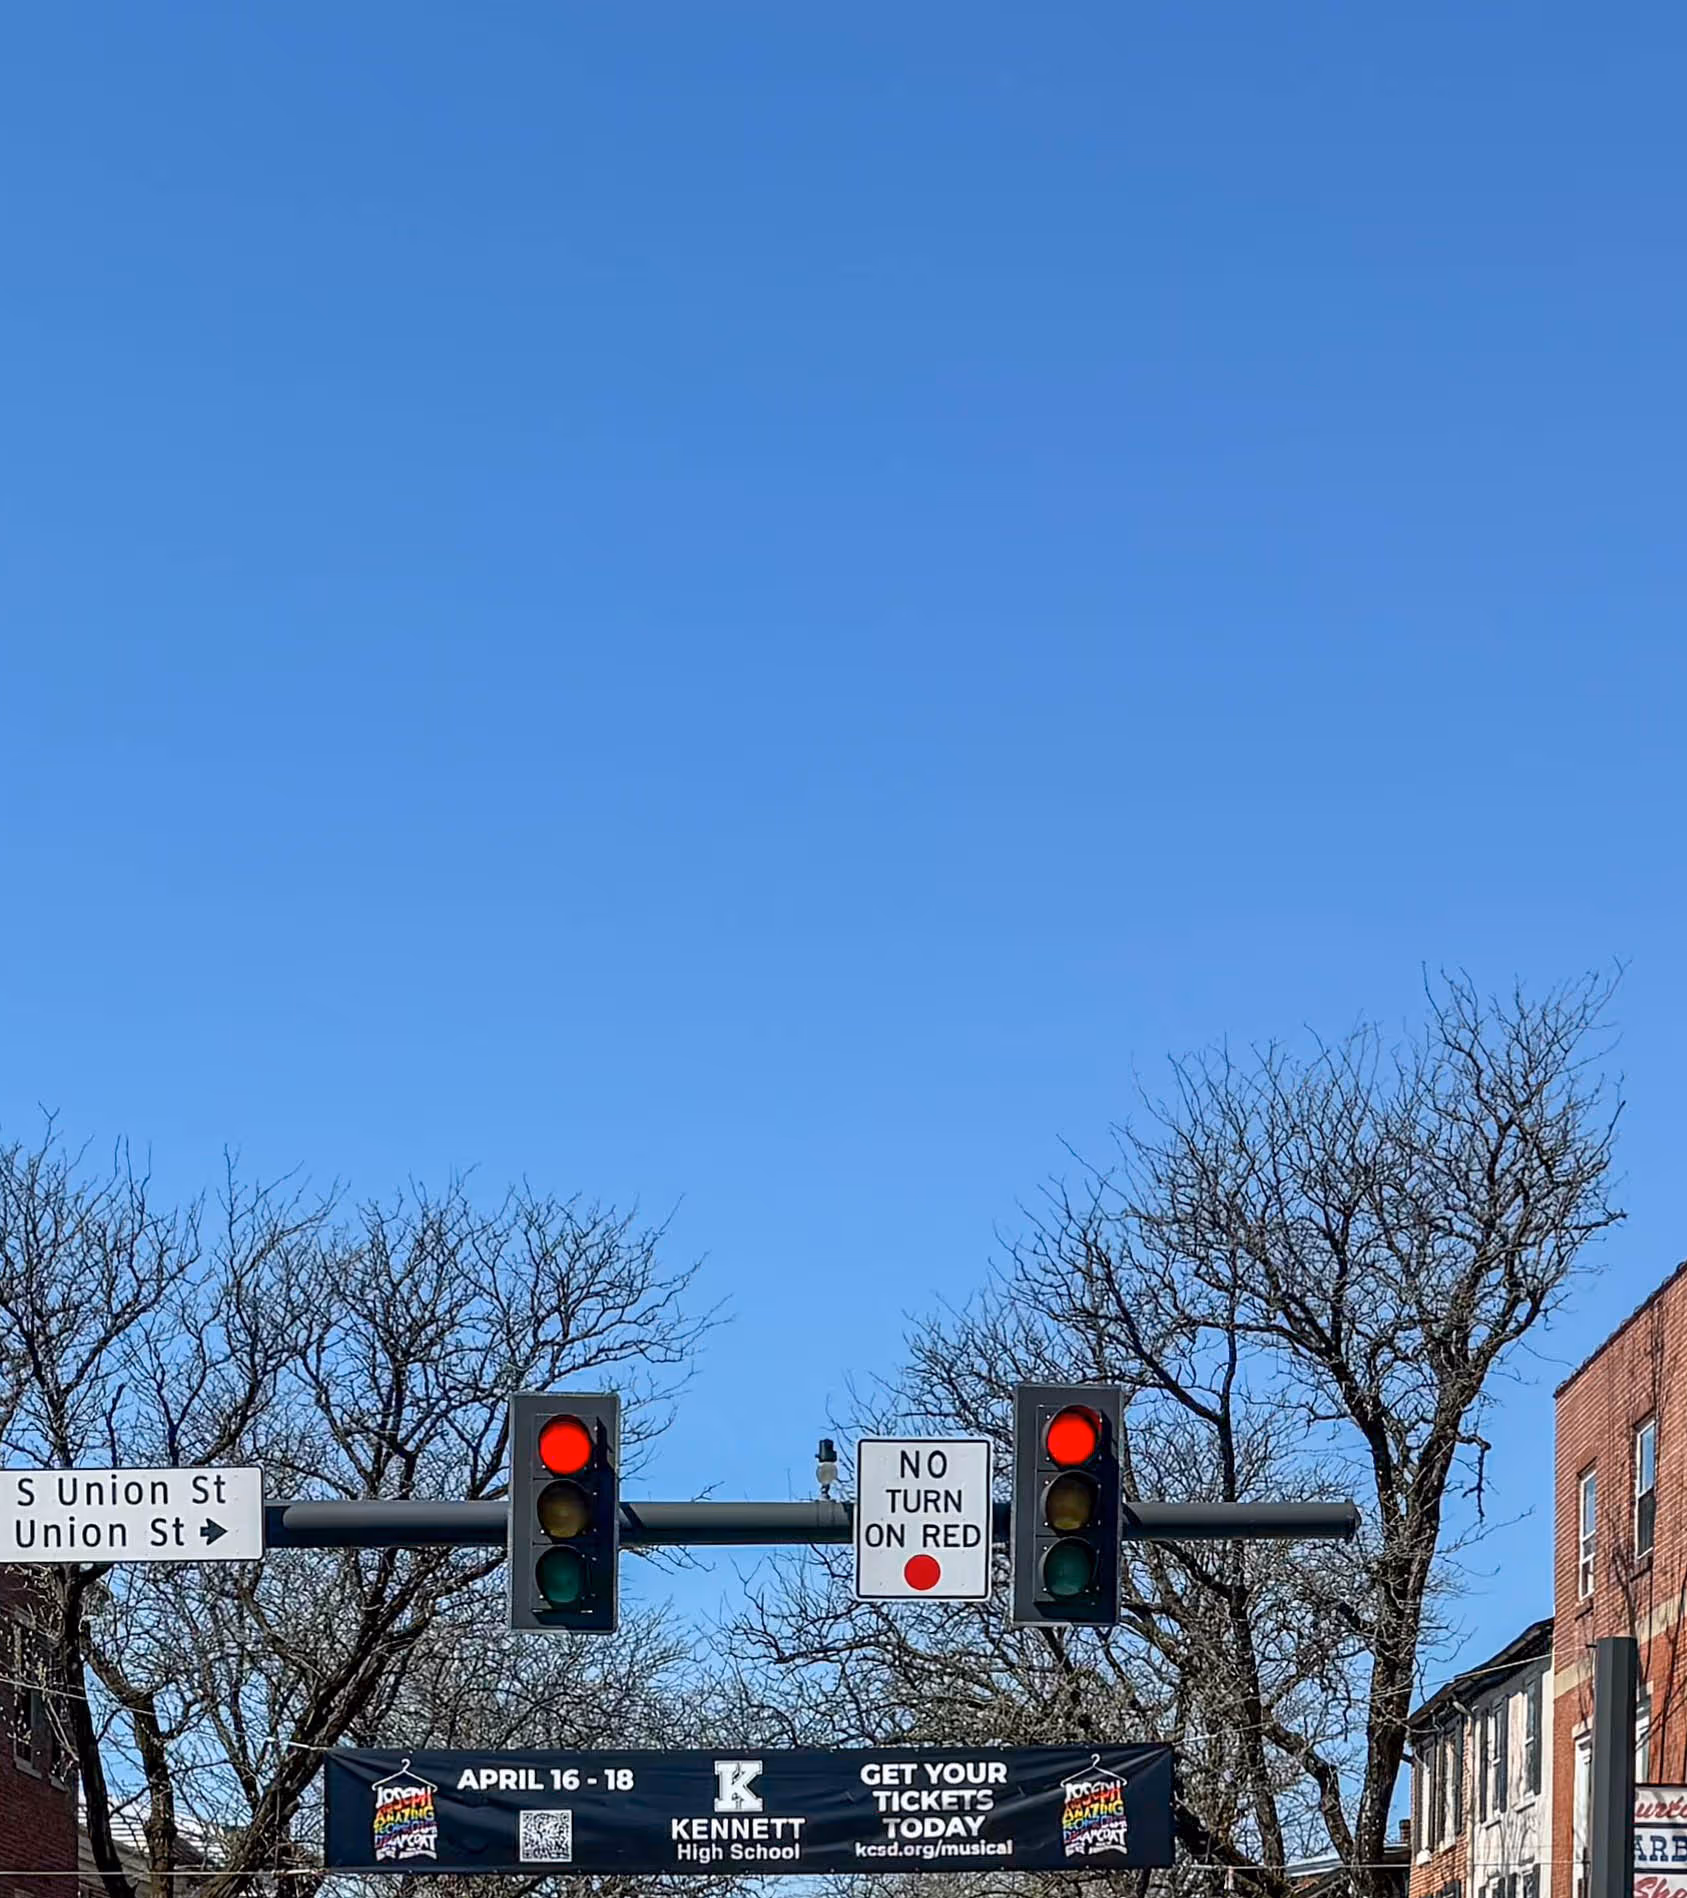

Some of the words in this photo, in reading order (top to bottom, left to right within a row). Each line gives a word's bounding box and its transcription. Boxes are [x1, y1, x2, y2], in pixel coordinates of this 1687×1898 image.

[901, 1450, 947, 1479] NO
[17, 1479, 35, 1506] S
[58, 1475, 169, 1506] Union
[192, 1475, 226, 1504] St
[886, 1489, 962, 1513] TURN
[16, 1517, 127, 1548] Union
[150, 1517, 185, 1547] St
[865, 1523, 905, 1548] ON
[922, 1523, 981, 1548] RED
[457, 1768, 544, 1790] APRIL
[550, 1768, 581, 1790] 16
[604, 1768, 634, 1790] 18
[860, 1763, 917, 1785] GET
[923, 1762, 1007, 1785] YOUR
[872, 1789, 994, 1812] TICKETS
[672, 1817, 806, 1840] KENNETT
[882, 1815, 986, 1839] TODAY
[678, 1843, 722, 1863] High
[729, 1842, 800, 1860] School
[855, 1839, 1013, 1859] kcsd.org/musical
